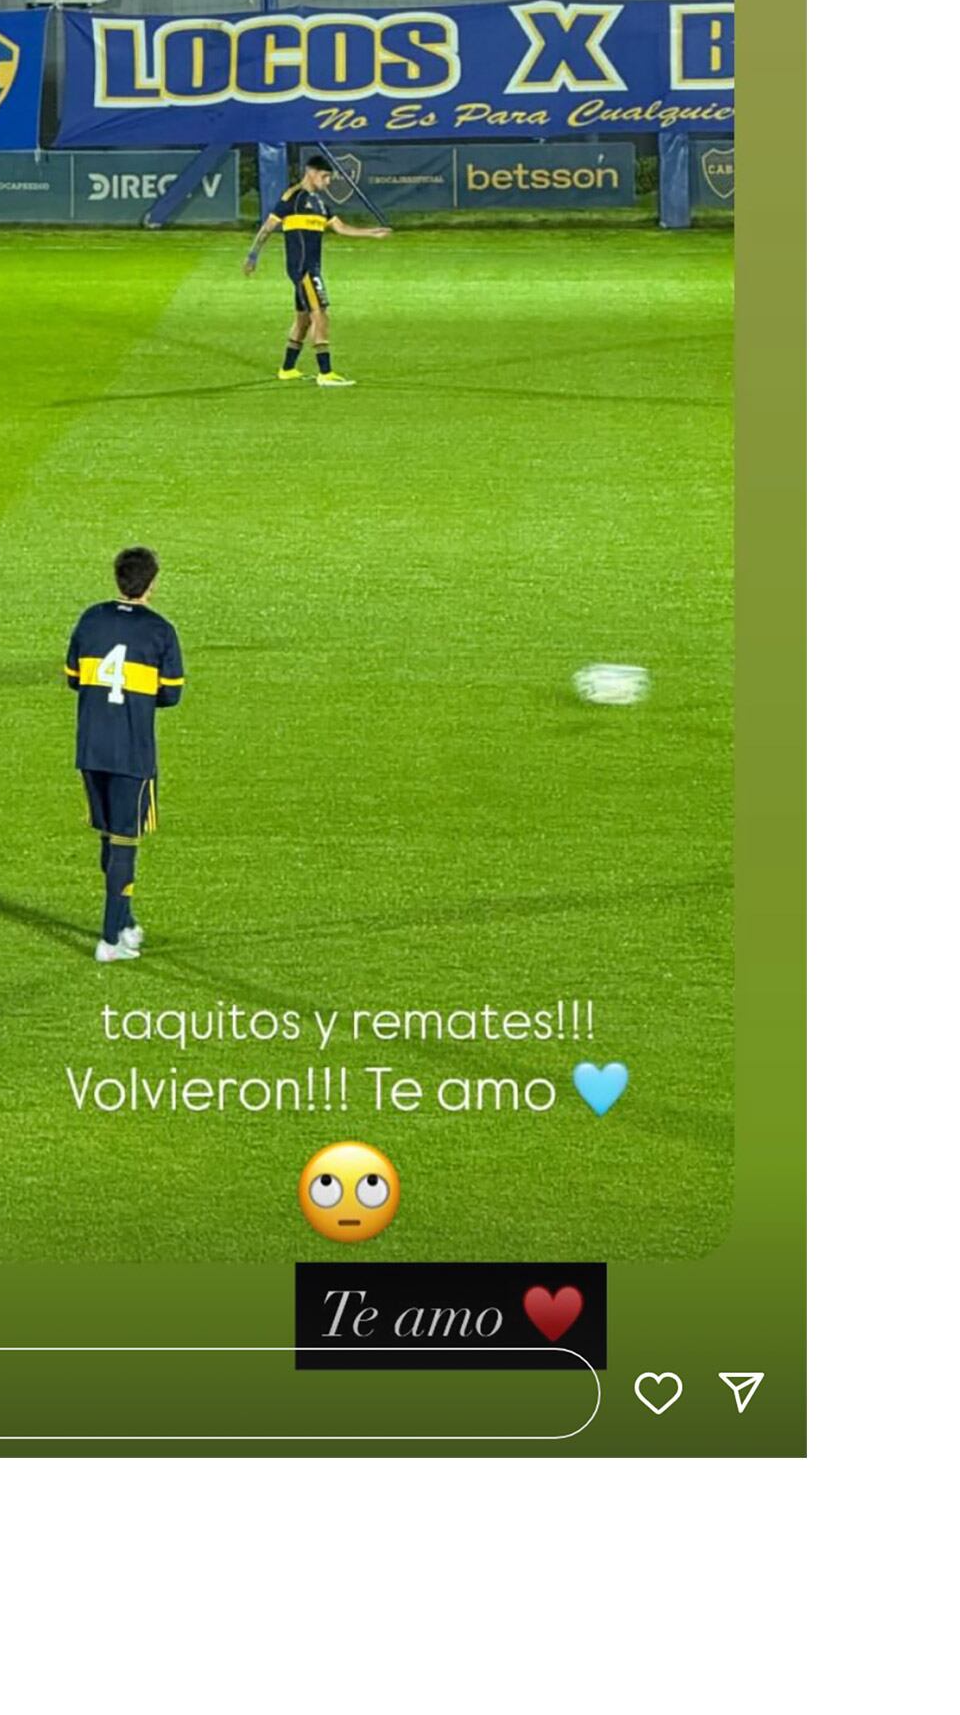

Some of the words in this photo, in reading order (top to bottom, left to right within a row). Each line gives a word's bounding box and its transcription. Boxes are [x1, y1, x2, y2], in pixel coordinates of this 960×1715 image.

[92, 12, 462, 108] LOCOS
[503, 3, 628, 94] X
[314, 107, 368, 131] No
[385, 105, 437, 129] Es
[454, 103, 551, 127] Para
[88, 173, 222, 200] DIRECV
[466, 163, 618, 191] betsson
[97, 643, 128, 704] 4
